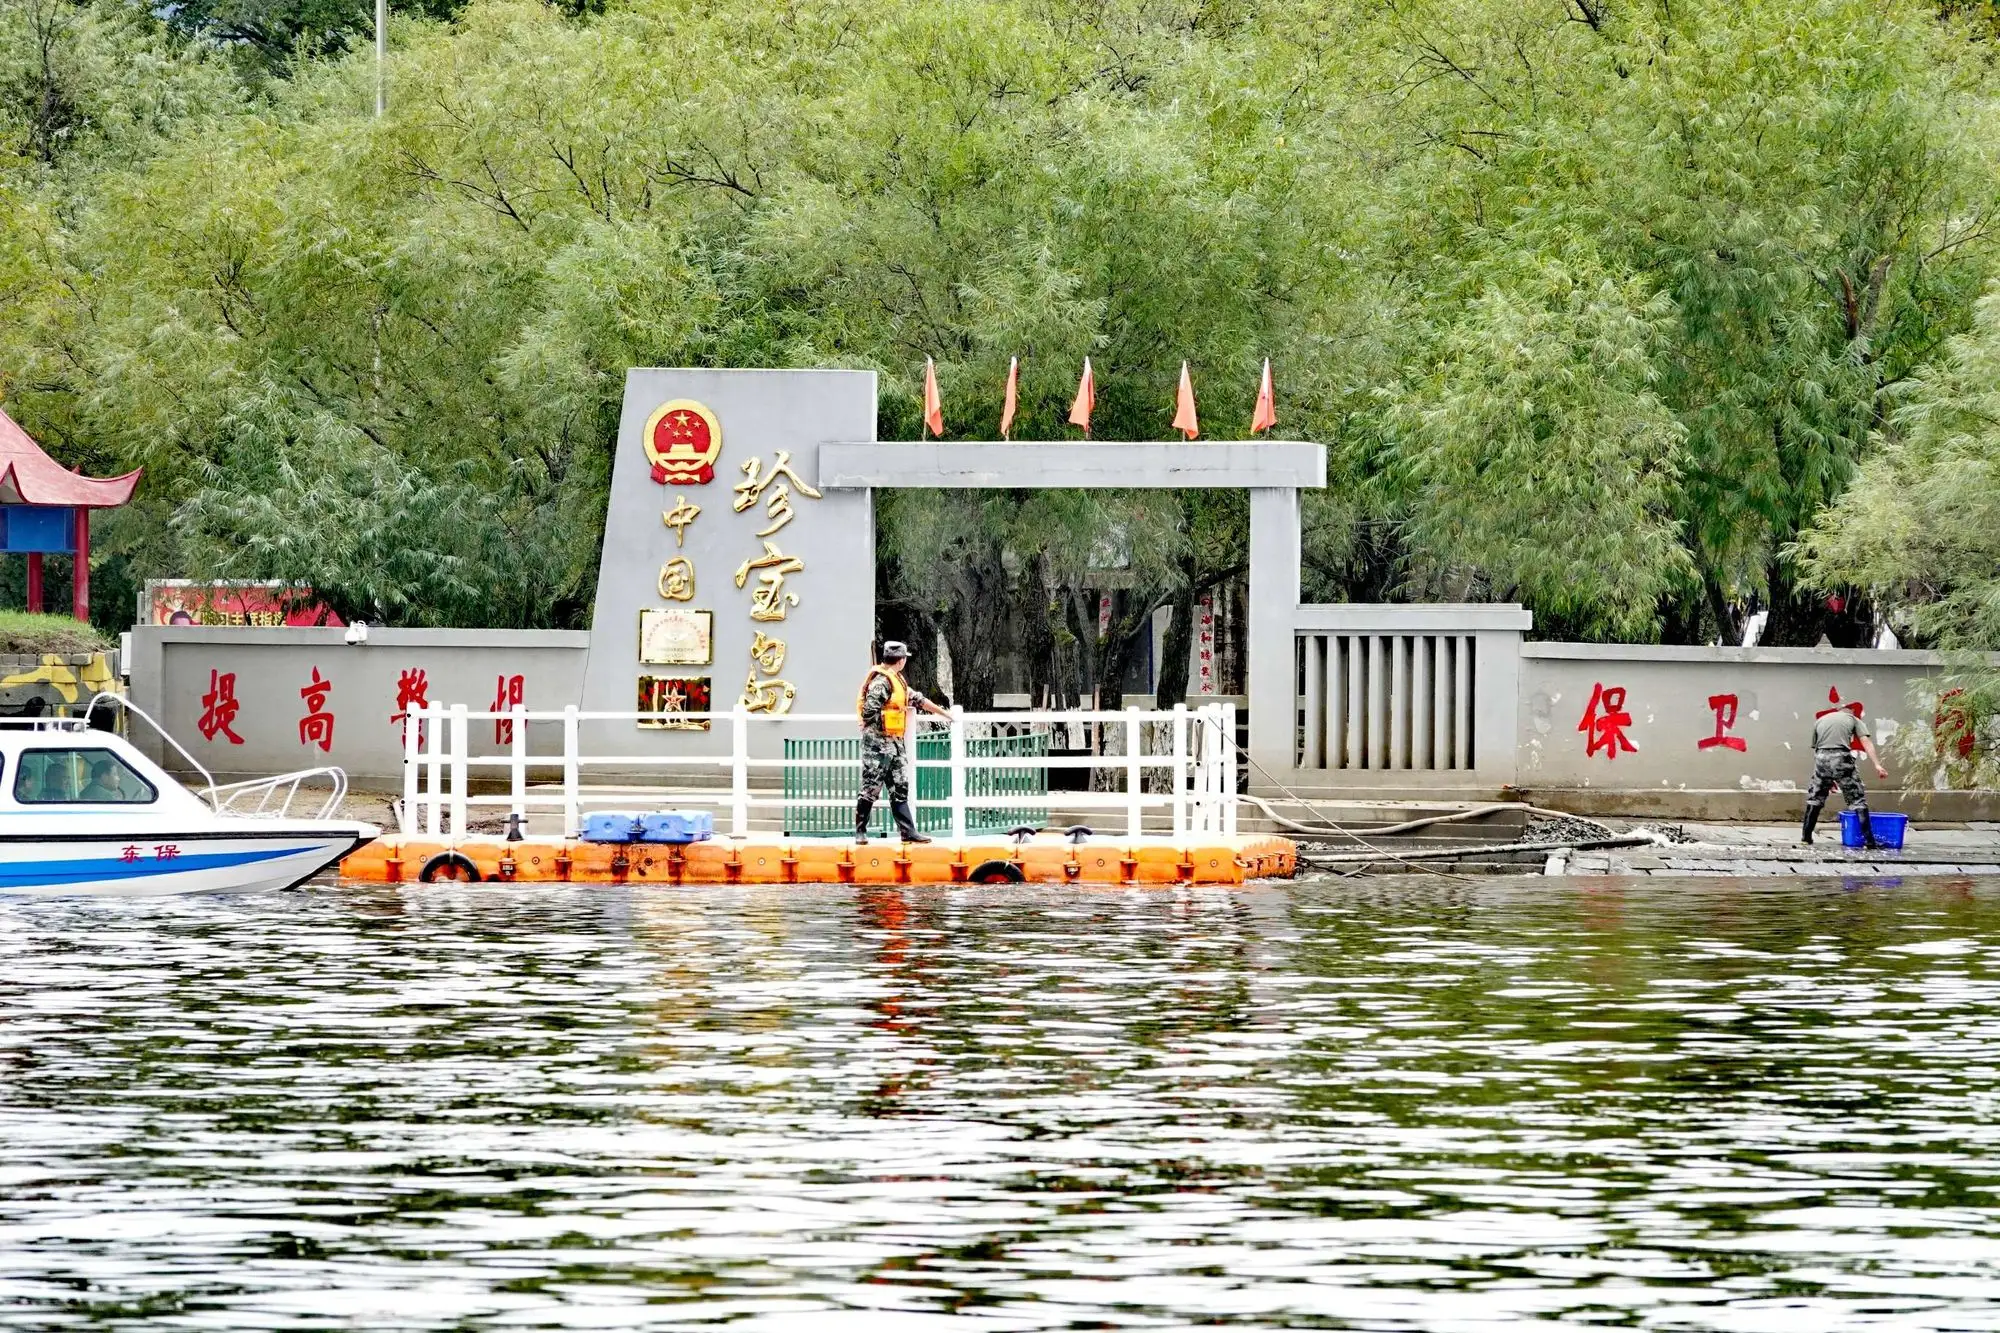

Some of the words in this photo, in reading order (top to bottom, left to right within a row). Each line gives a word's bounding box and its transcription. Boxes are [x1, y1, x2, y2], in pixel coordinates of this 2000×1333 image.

[658, 494, 701, 601] 中国
[198, 666, 528, 753] 提高警惕
[117, 844, 181, 863] 东保
